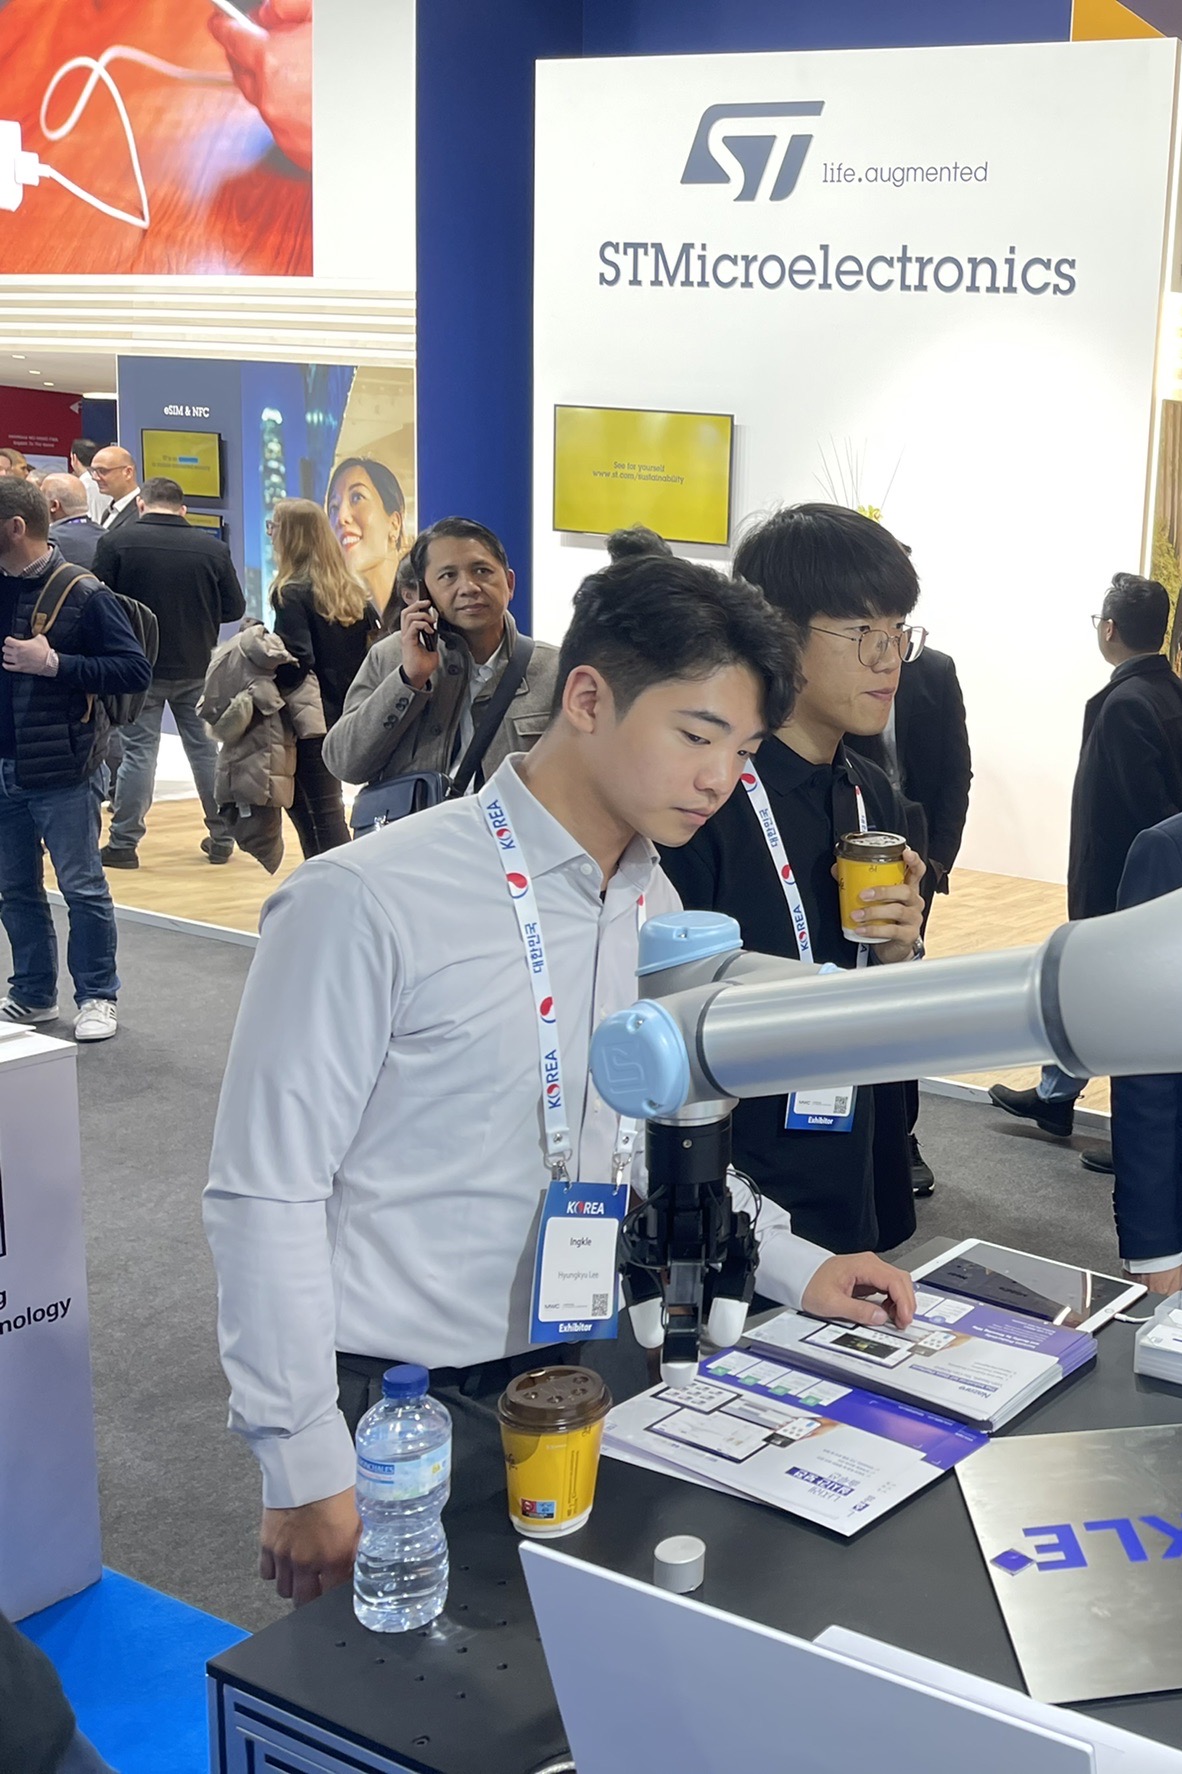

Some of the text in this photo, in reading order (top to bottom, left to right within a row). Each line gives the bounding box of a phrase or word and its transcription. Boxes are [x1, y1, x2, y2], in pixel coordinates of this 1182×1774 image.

[822, 161, 989, 188] life.augmented
[598, 240, 1078, 297] STMicroelectronics
[163, 404, 210, 418] eSIM & NFC
[613, 461, 665, 473] See for yourself
[487, 799, 516, 850] KOREA
[793, 904, 809, 952] KOREA
[524, 922, 545, 974] 대한민국
[546, 1049, 562, 1110] KOREA
[807, 1116, 834, 1125] Exhibitor
[566, 1200, 605, 1215] KOREA
[570, 1237, 592, 1249] Ingkle
[0, 1298, 72, 1336] nology
[558, 1323, 593, 1333] Exhibitor
